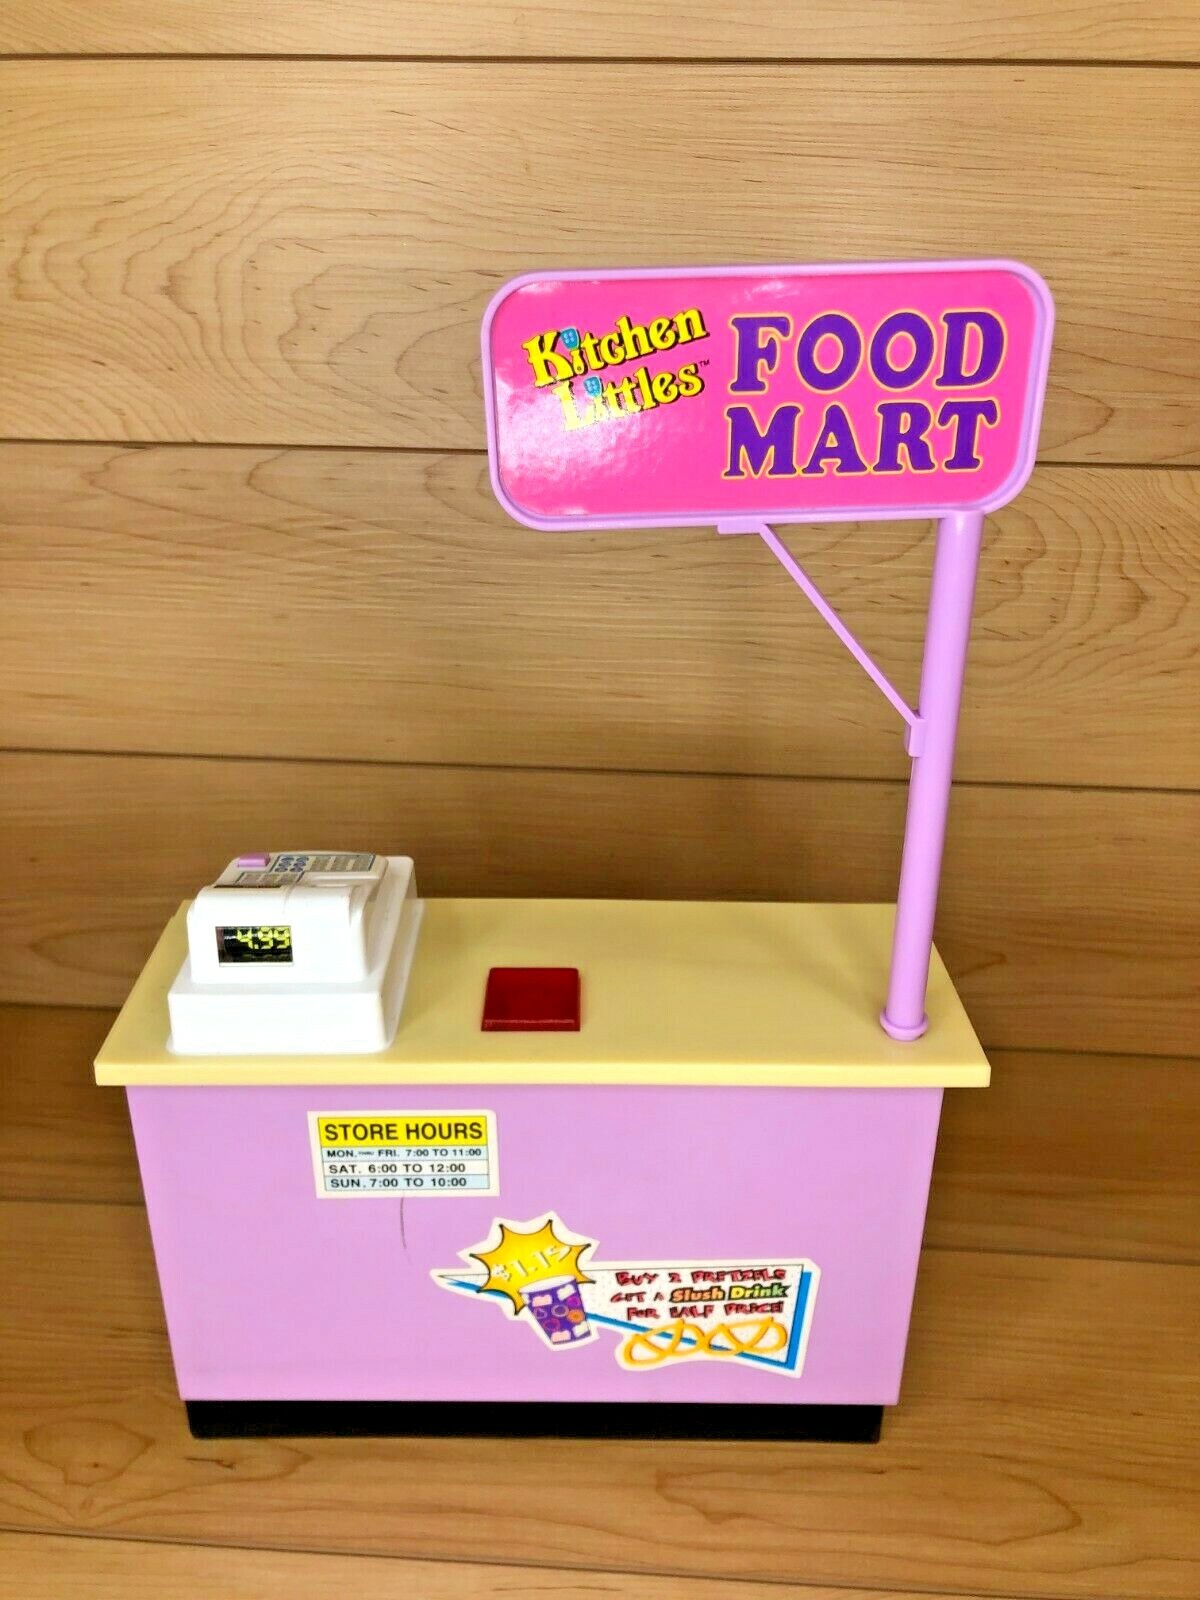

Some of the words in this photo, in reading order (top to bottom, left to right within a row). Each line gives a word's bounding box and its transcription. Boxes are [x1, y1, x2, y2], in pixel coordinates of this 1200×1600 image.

[521, 307, 710, 388] Kitchen
[729, 309, 1006, 394] FOOD
[551, 363, 705, 431] Littles
[722, 398, 1000, 479] MART
[324, 1123, 399, 1141] STORE
[406, 1122, 483, 1140] HOURS
[406, 1149, 429, 1157] 7:00
[432, 1149, 448, 1157] TO
[452, 1148, 482, 1157] 11:00
[328, 1164, 362, 1174] SAT.
[368, 1164, 397, 1173] 6:00
[402, 1164, 423, 1173] TO
[429, 1163, 466, 1173] 12:00
[330, 1178, 367, 1188] SUN.
[370, 1178, 398, 1188] 7:00
[404, 1178, 424, 1187] TO
[431, 1177, 467, 1187] 10:00
[615, 1271, 659, 1286] BUY
[668, 1272, 682, 1283] 2
[670, 1286, 726, 1303] Slush
[728, 1283, 791, 1301] Drink
